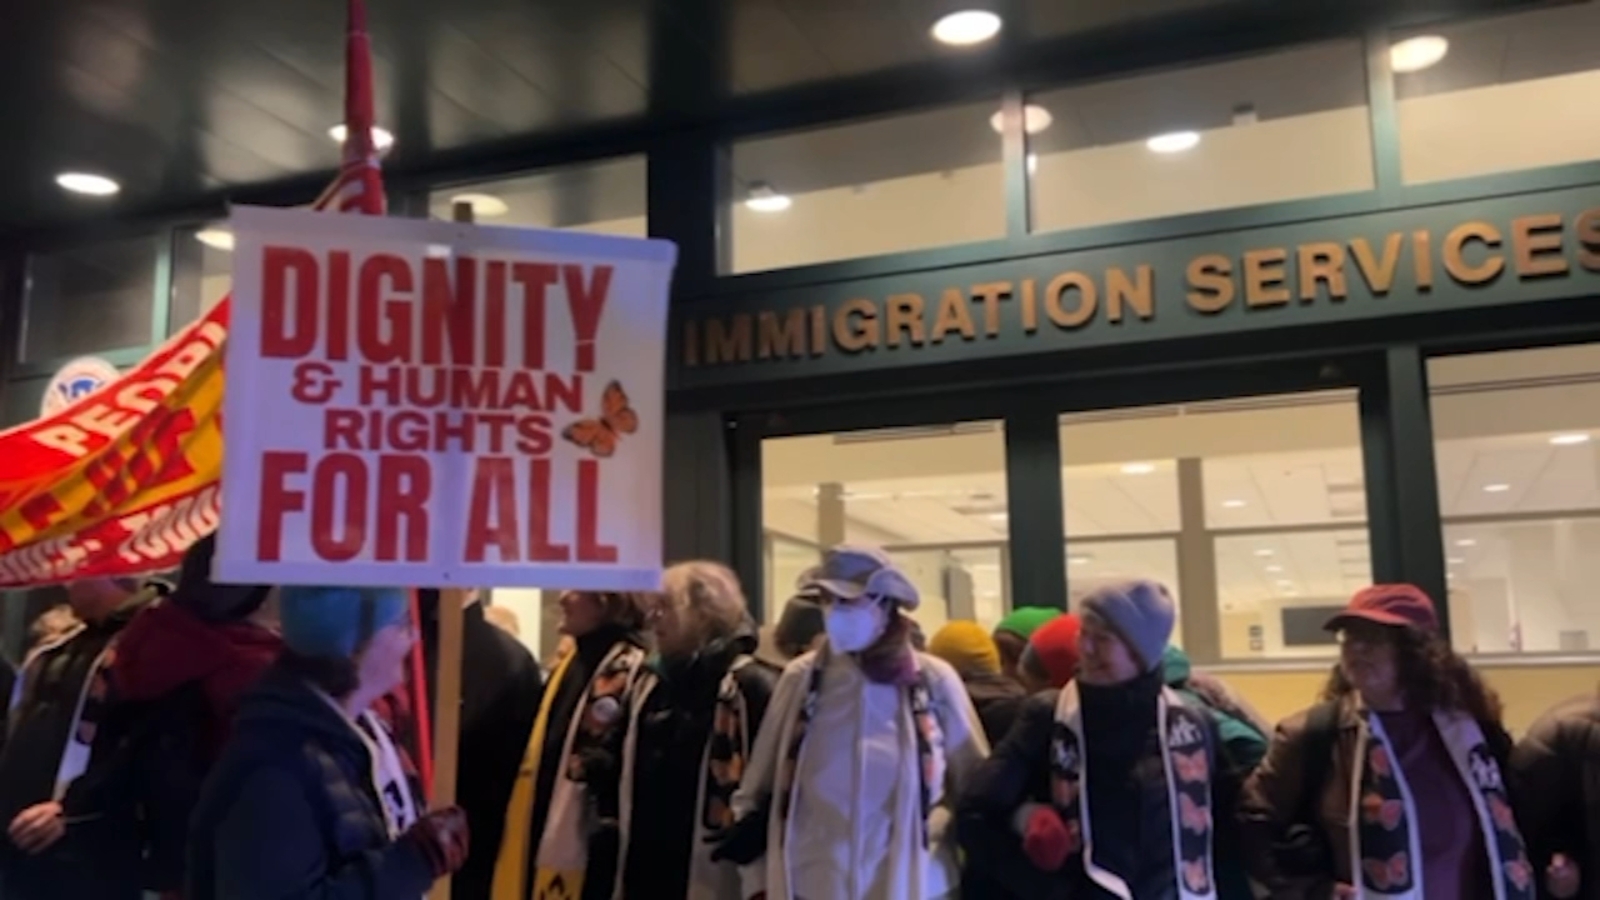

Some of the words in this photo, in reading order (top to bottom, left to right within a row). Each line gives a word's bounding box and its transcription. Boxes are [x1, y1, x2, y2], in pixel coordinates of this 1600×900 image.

[260, 245, 614, 373] DIGNITY
[684, 265, 1154, 367] IMMIGRATION
[290, 362, 342, 405] &
[359, 364, 583, 414] HUMAN
[323, 408, 554, 455] RIGHTS
[256, 450, 432, 563] FOR
[463, 456, 619, 564] ALL
